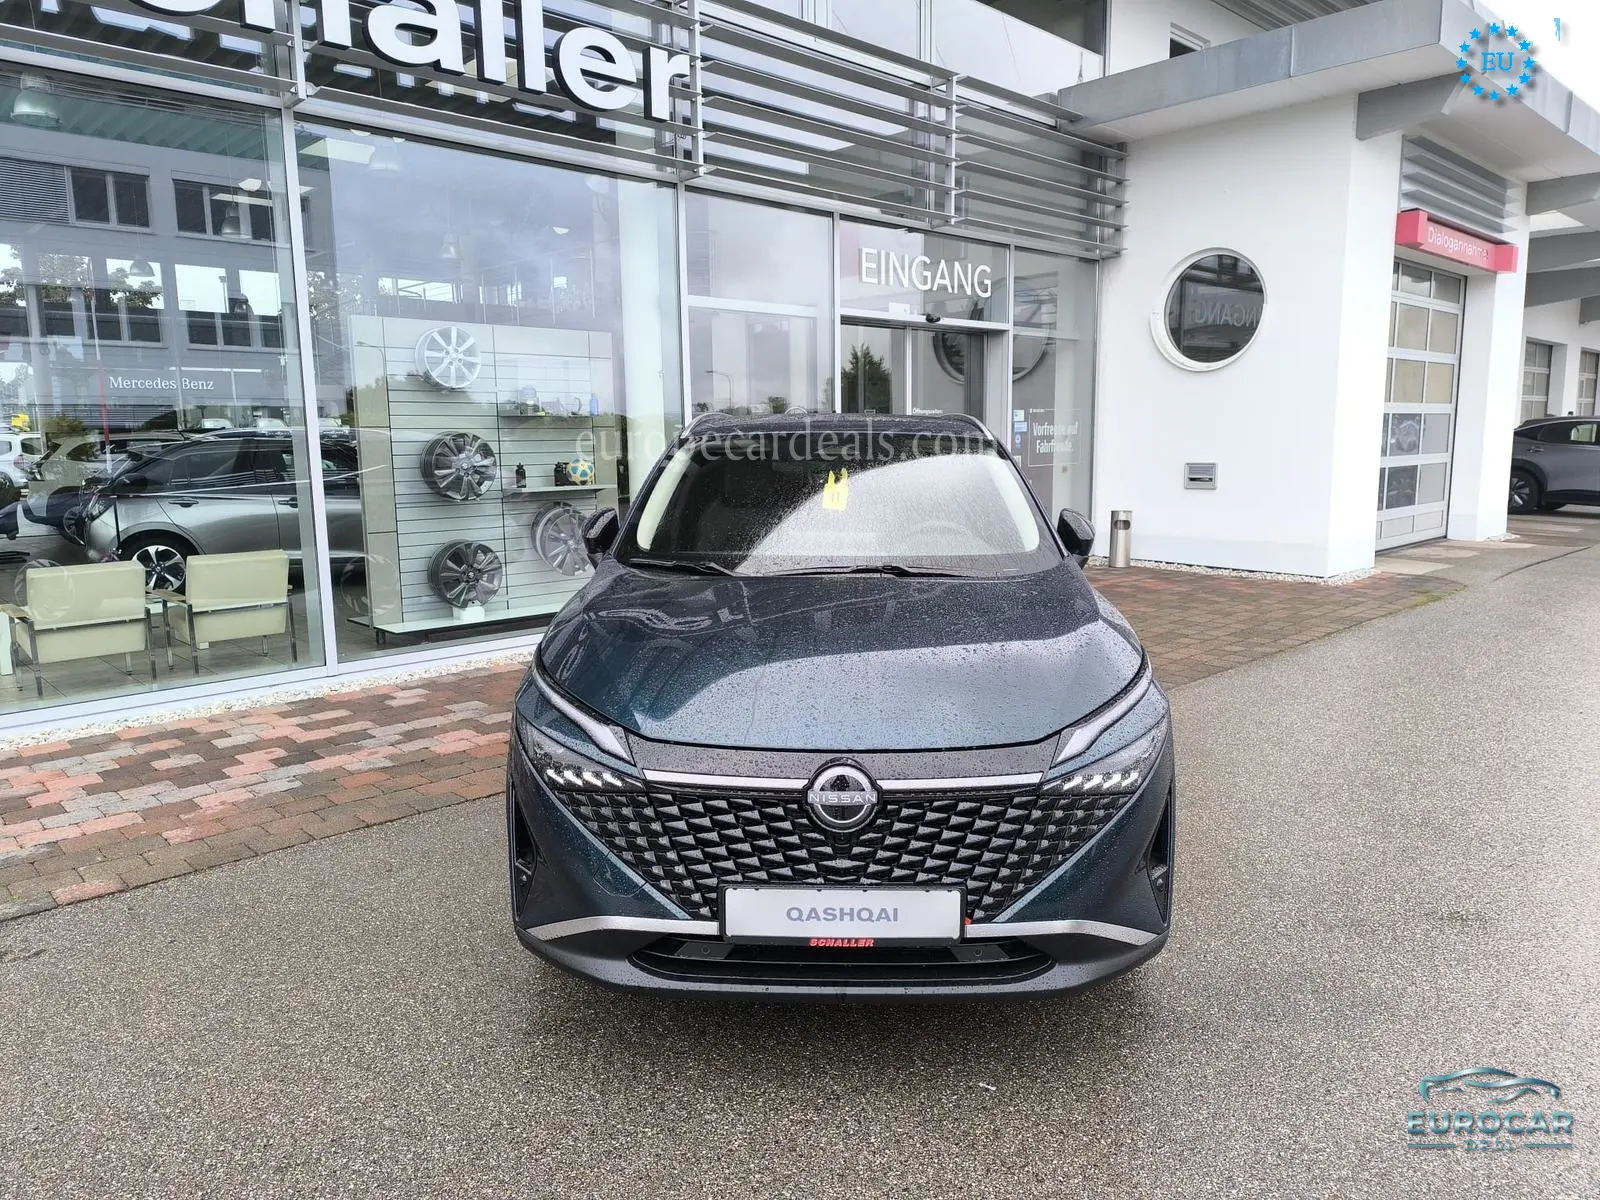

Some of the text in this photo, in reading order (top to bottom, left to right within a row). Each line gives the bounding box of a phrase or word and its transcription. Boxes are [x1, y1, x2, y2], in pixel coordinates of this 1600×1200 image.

[128, 0, 690, 122] aller
[859, 247, 992, 298] EINGANG
[109, 376, 215, 390] Mercedes Benz
[809, 791, 876, 804] NISSAN
[786, 907, 899, 923] QASHQAI
[809, 938, 874, 948] SCHALLER
